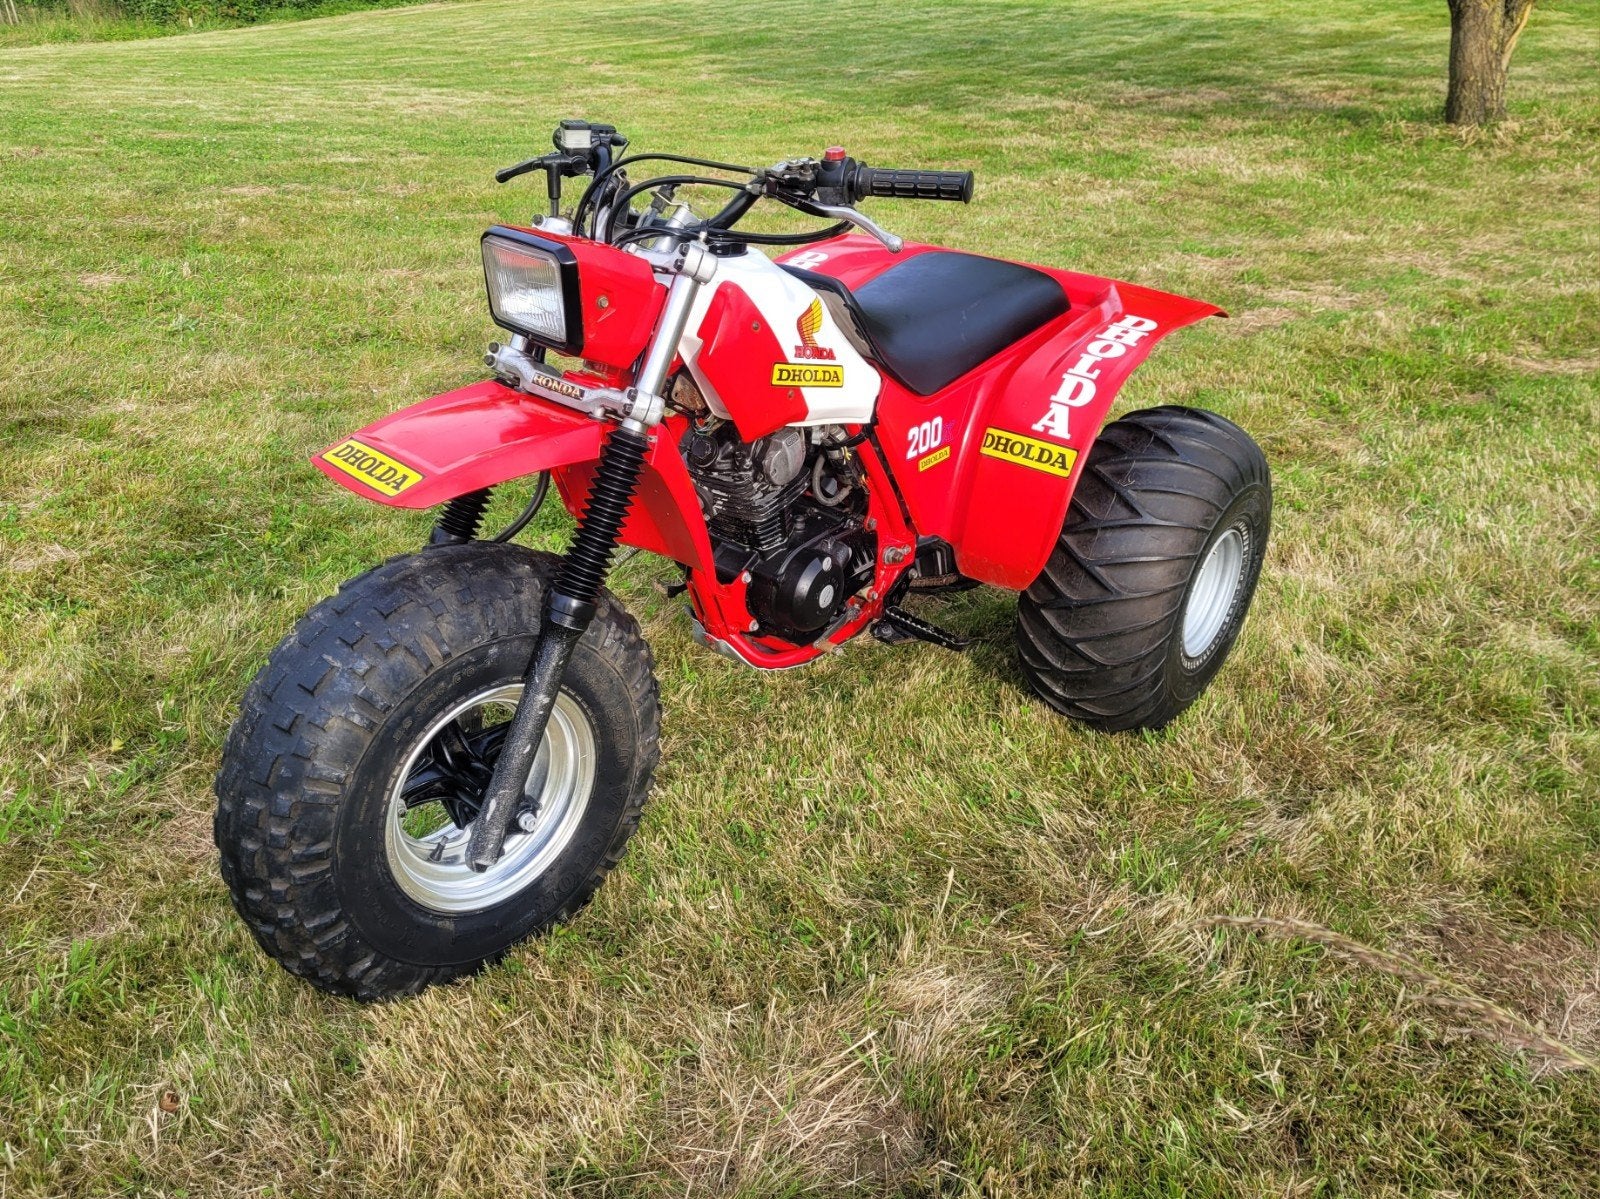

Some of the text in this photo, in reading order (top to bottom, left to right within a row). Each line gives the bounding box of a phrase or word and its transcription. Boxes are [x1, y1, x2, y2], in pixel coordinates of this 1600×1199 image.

[794, 345, 836, 361] HONDA
[533, 374, 582, 399] HONDA
[776, 368, 841, 383] DHOLDA
[1031, 314, 1158, 440] DHOLDA
[920, 449, 949, 469] DHOLDA
[983, 432, 1069, 471] DHOLDA
[332, 443, 410, 491] DHOLDA
